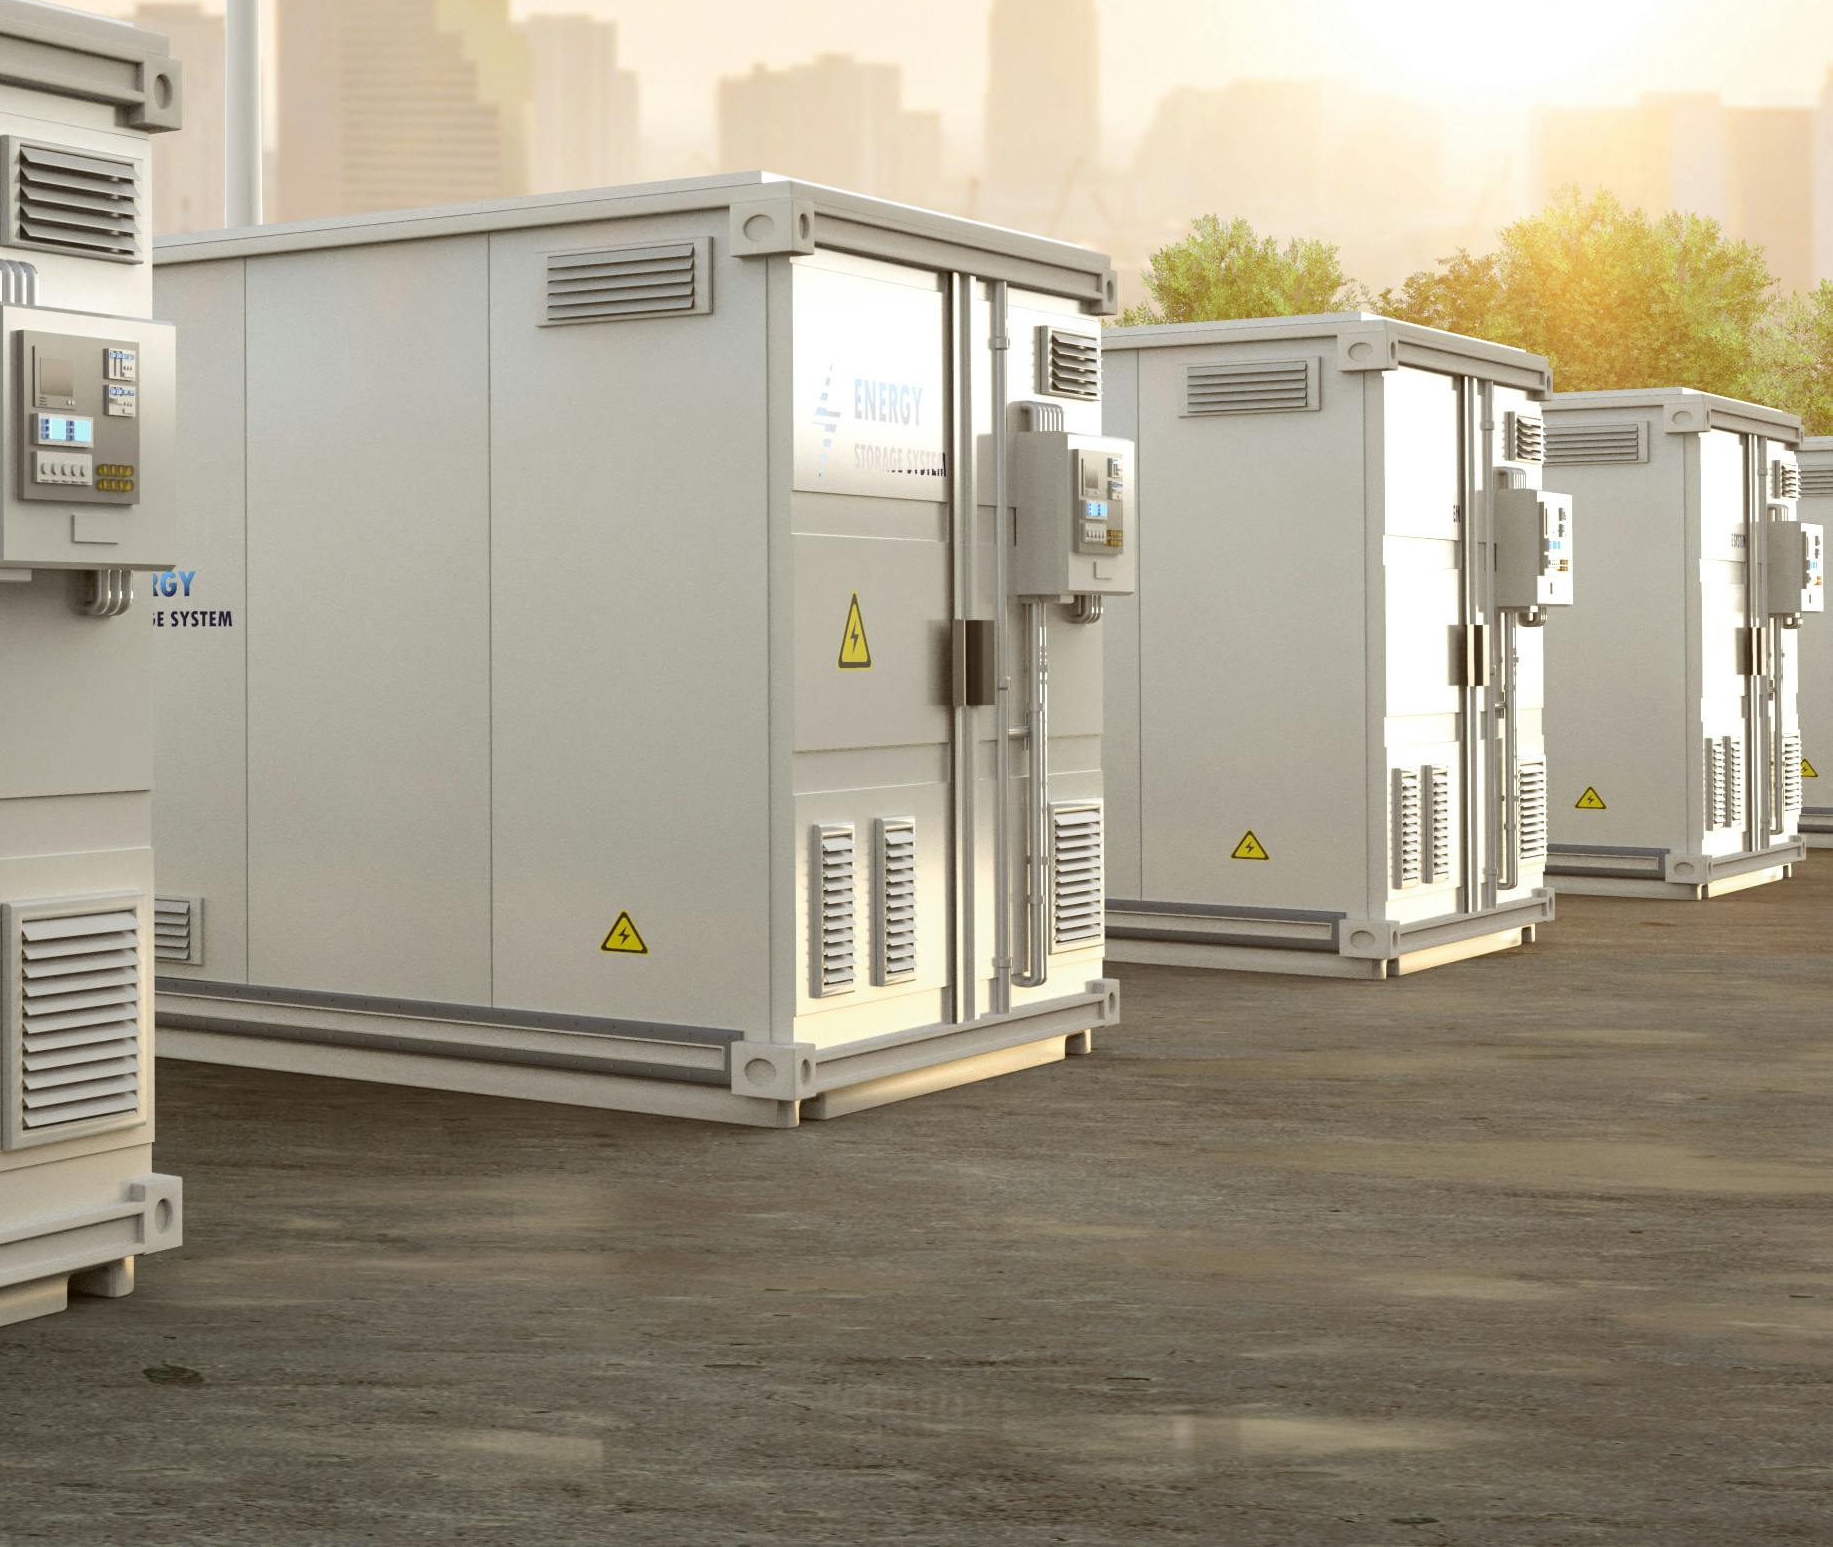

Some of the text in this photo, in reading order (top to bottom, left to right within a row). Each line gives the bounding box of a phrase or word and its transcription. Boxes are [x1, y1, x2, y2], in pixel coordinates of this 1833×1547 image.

[854, 378, 923, 427] ENERGY
[854, 443, 903, 473] STORAGE
[170, 610, 233, 627] SYSTEM
